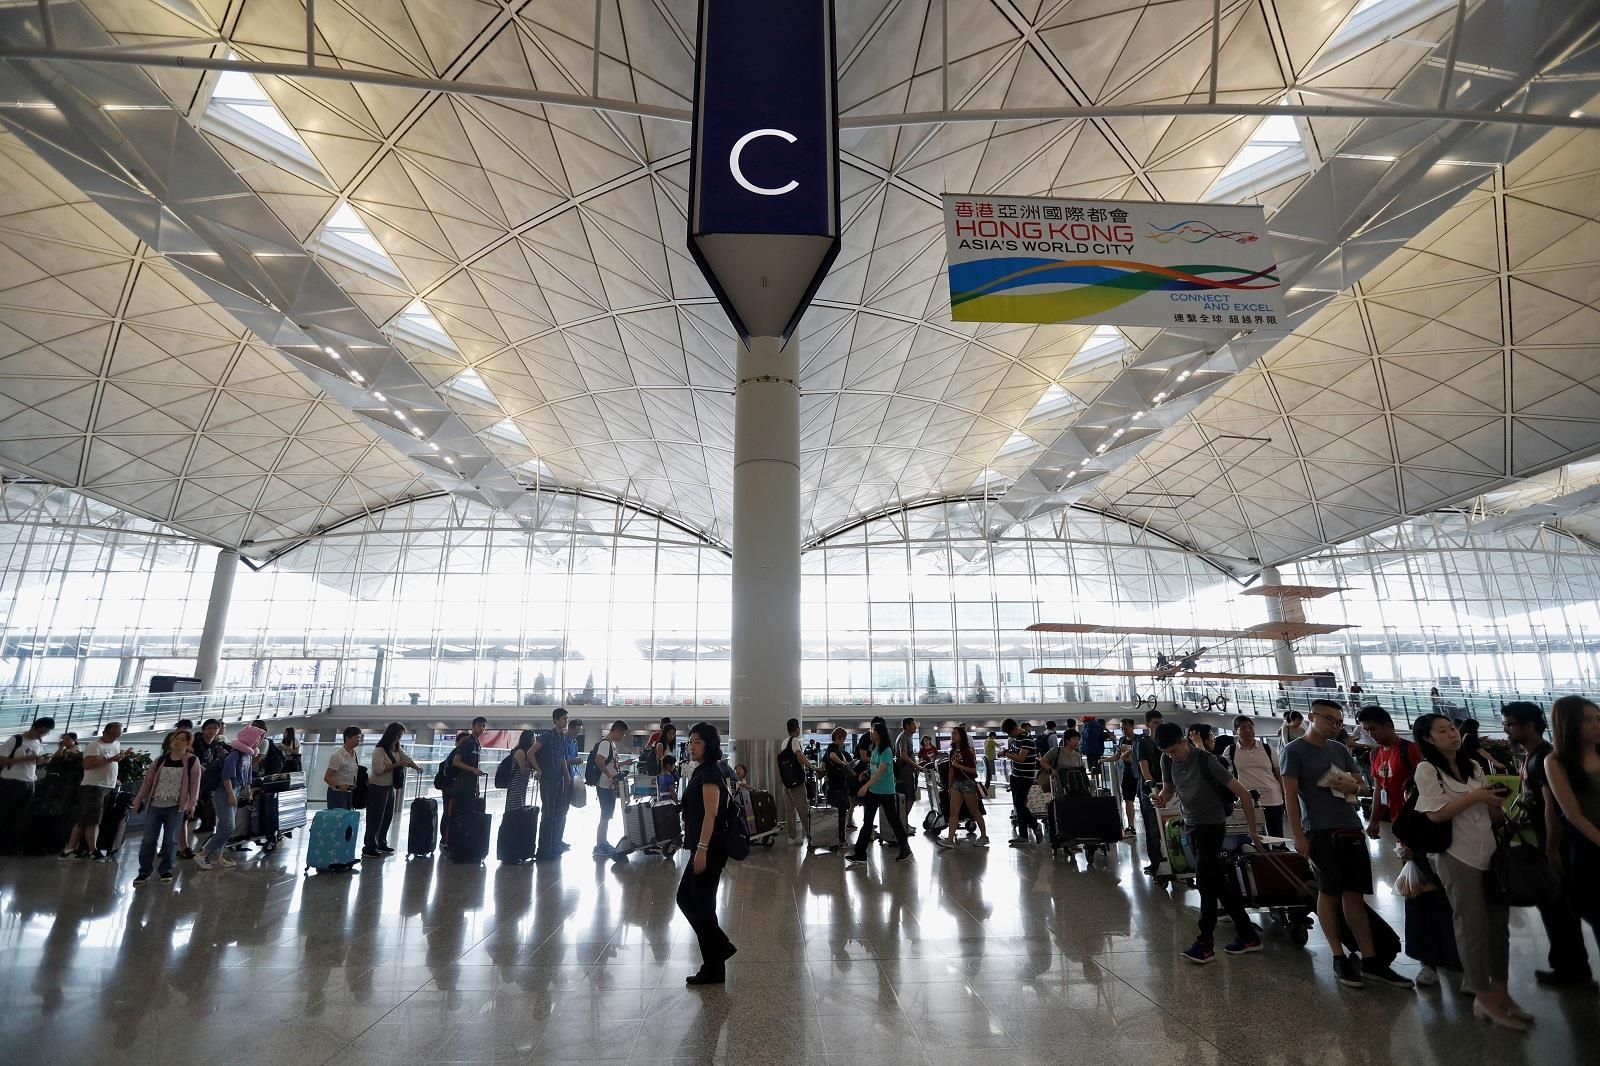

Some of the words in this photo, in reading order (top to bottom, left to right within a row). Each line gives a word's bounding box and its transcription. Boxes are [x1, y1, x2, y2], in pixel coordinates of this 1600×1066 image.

[729, 128, 800, 196] C
[955, 219, 1042, 239] HONG
[1049, 222, 1134, 243] KONG
[1022, 241, 1089, 254] WORLD
[1092, 243, 1136, 256] CITY
[1170, 293, 1231, 302] CONNECT
[1203, 303, 1230, 311] AND
[1234, 303, 1274, 312] EXCEL
